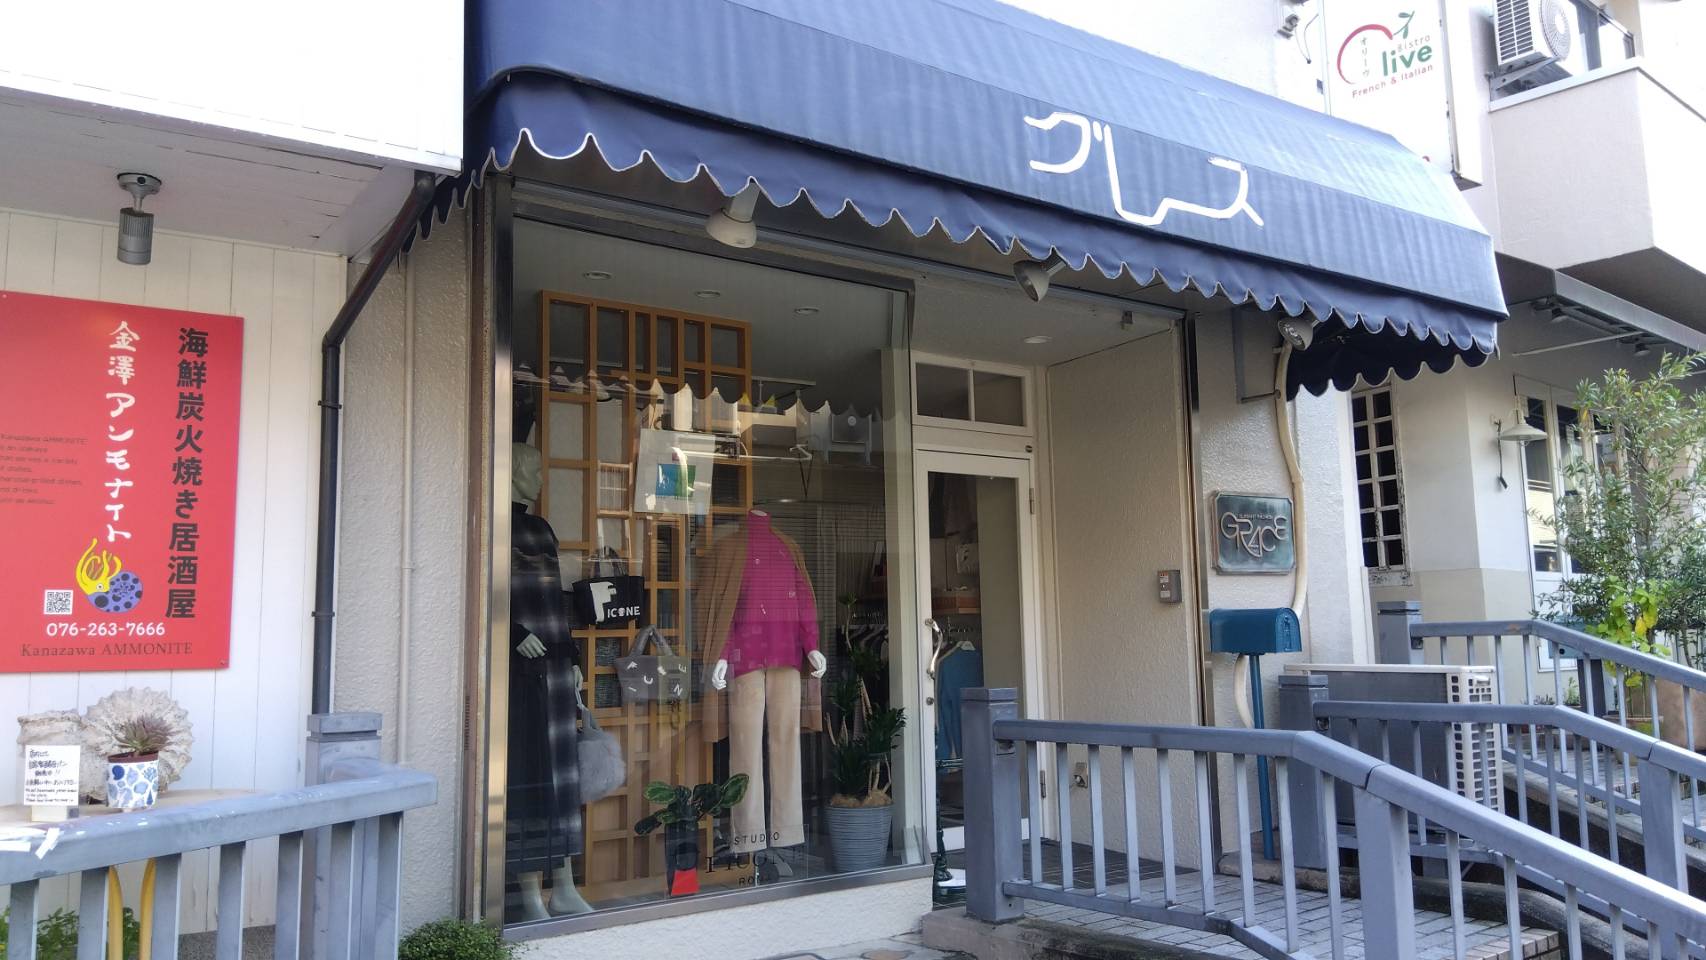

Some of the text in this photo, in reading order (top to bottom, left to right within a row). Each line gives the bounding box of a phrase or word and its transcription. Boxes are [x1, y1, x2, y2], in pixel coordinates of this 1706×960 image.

[1352, 64, 1434, 99] French & Italian
[104, 320, 141, 542] 金澤アンモナイト
[165, 326, 209, 619] 海鮮炭火焼き居酒屋
[1221, 511, 1288, 558] GRACE
[46, 622, 166, 637] 076-263-7666
[20, 641, 193, 657] Kanazawa AMMONITE
[734, 831, 781, 846] STUDIO
